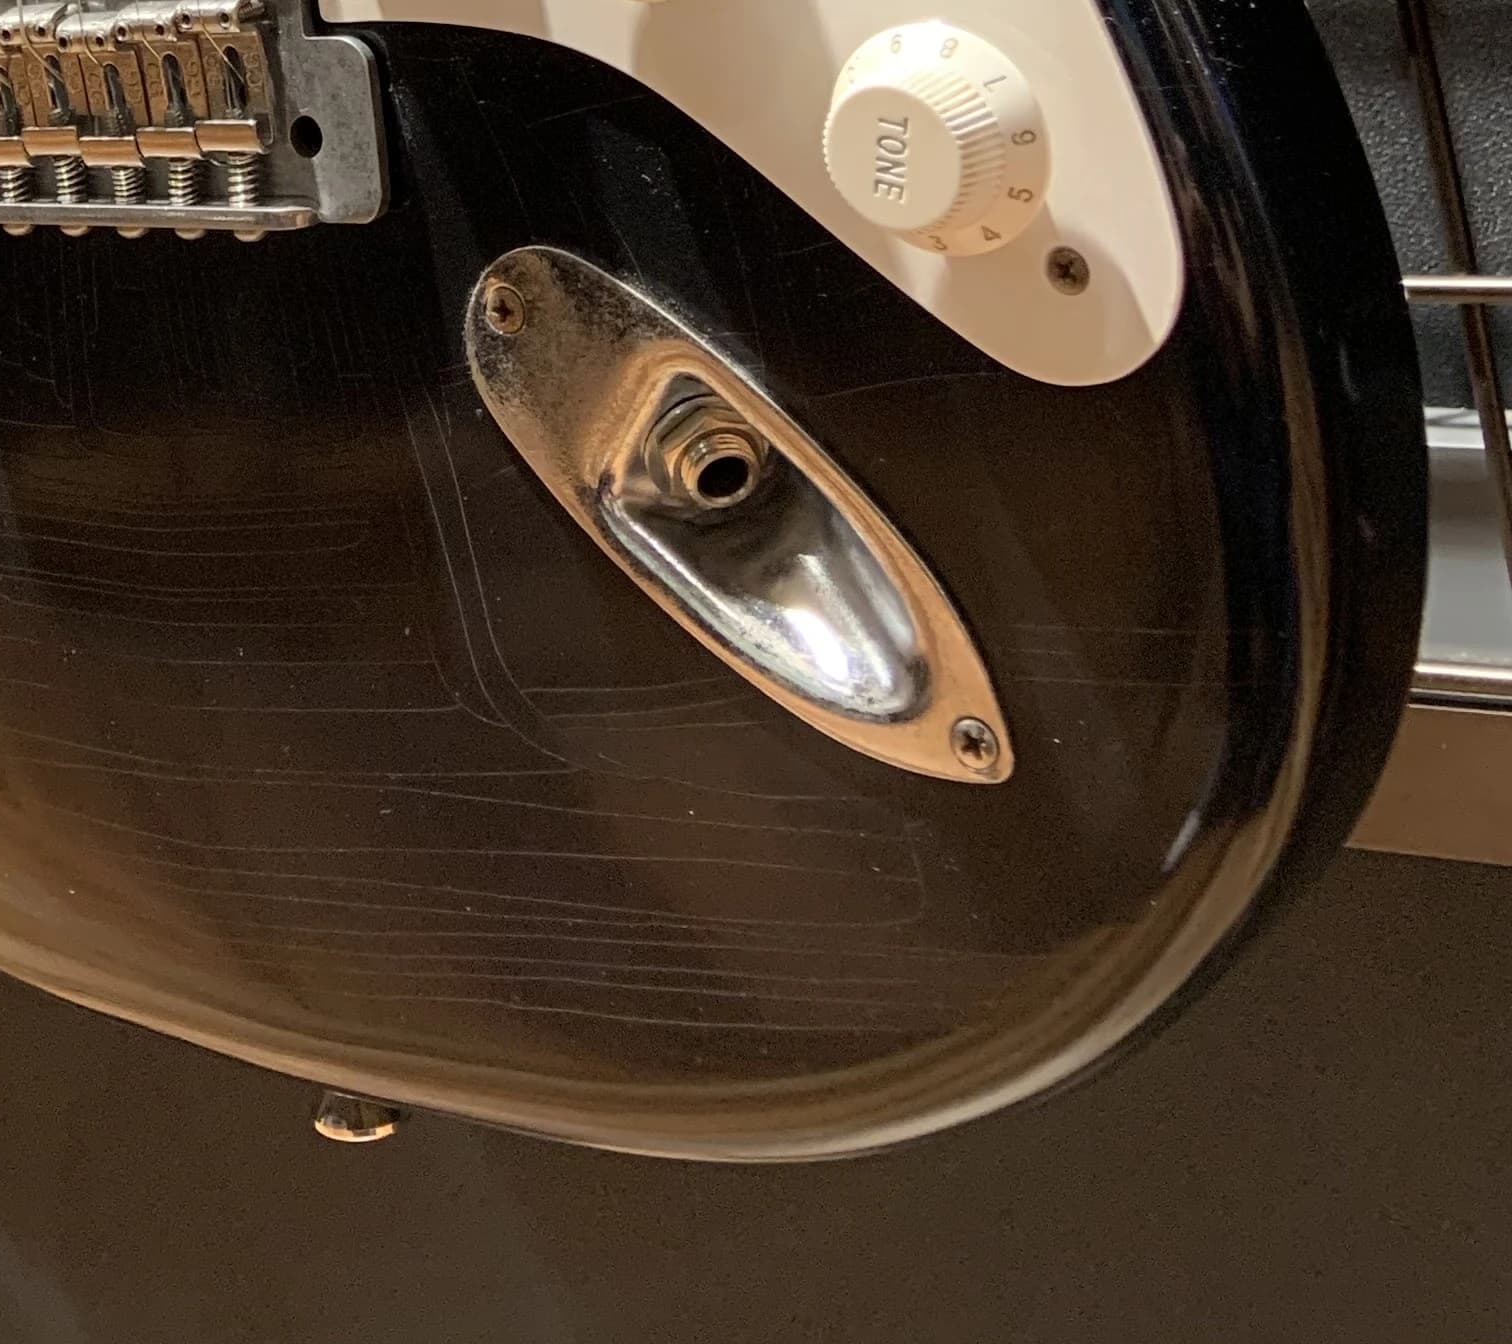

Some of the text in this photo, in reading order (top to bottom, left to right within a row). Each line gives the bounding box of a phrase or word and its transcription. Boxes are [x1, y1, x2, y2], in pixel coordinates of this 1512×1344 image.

[1011, 129, 1037, 147] 6
[873, 116, 910, 205] TONE
[1007, 186, 1034, 203] 5
[980, 224, 1002, 242] 4
